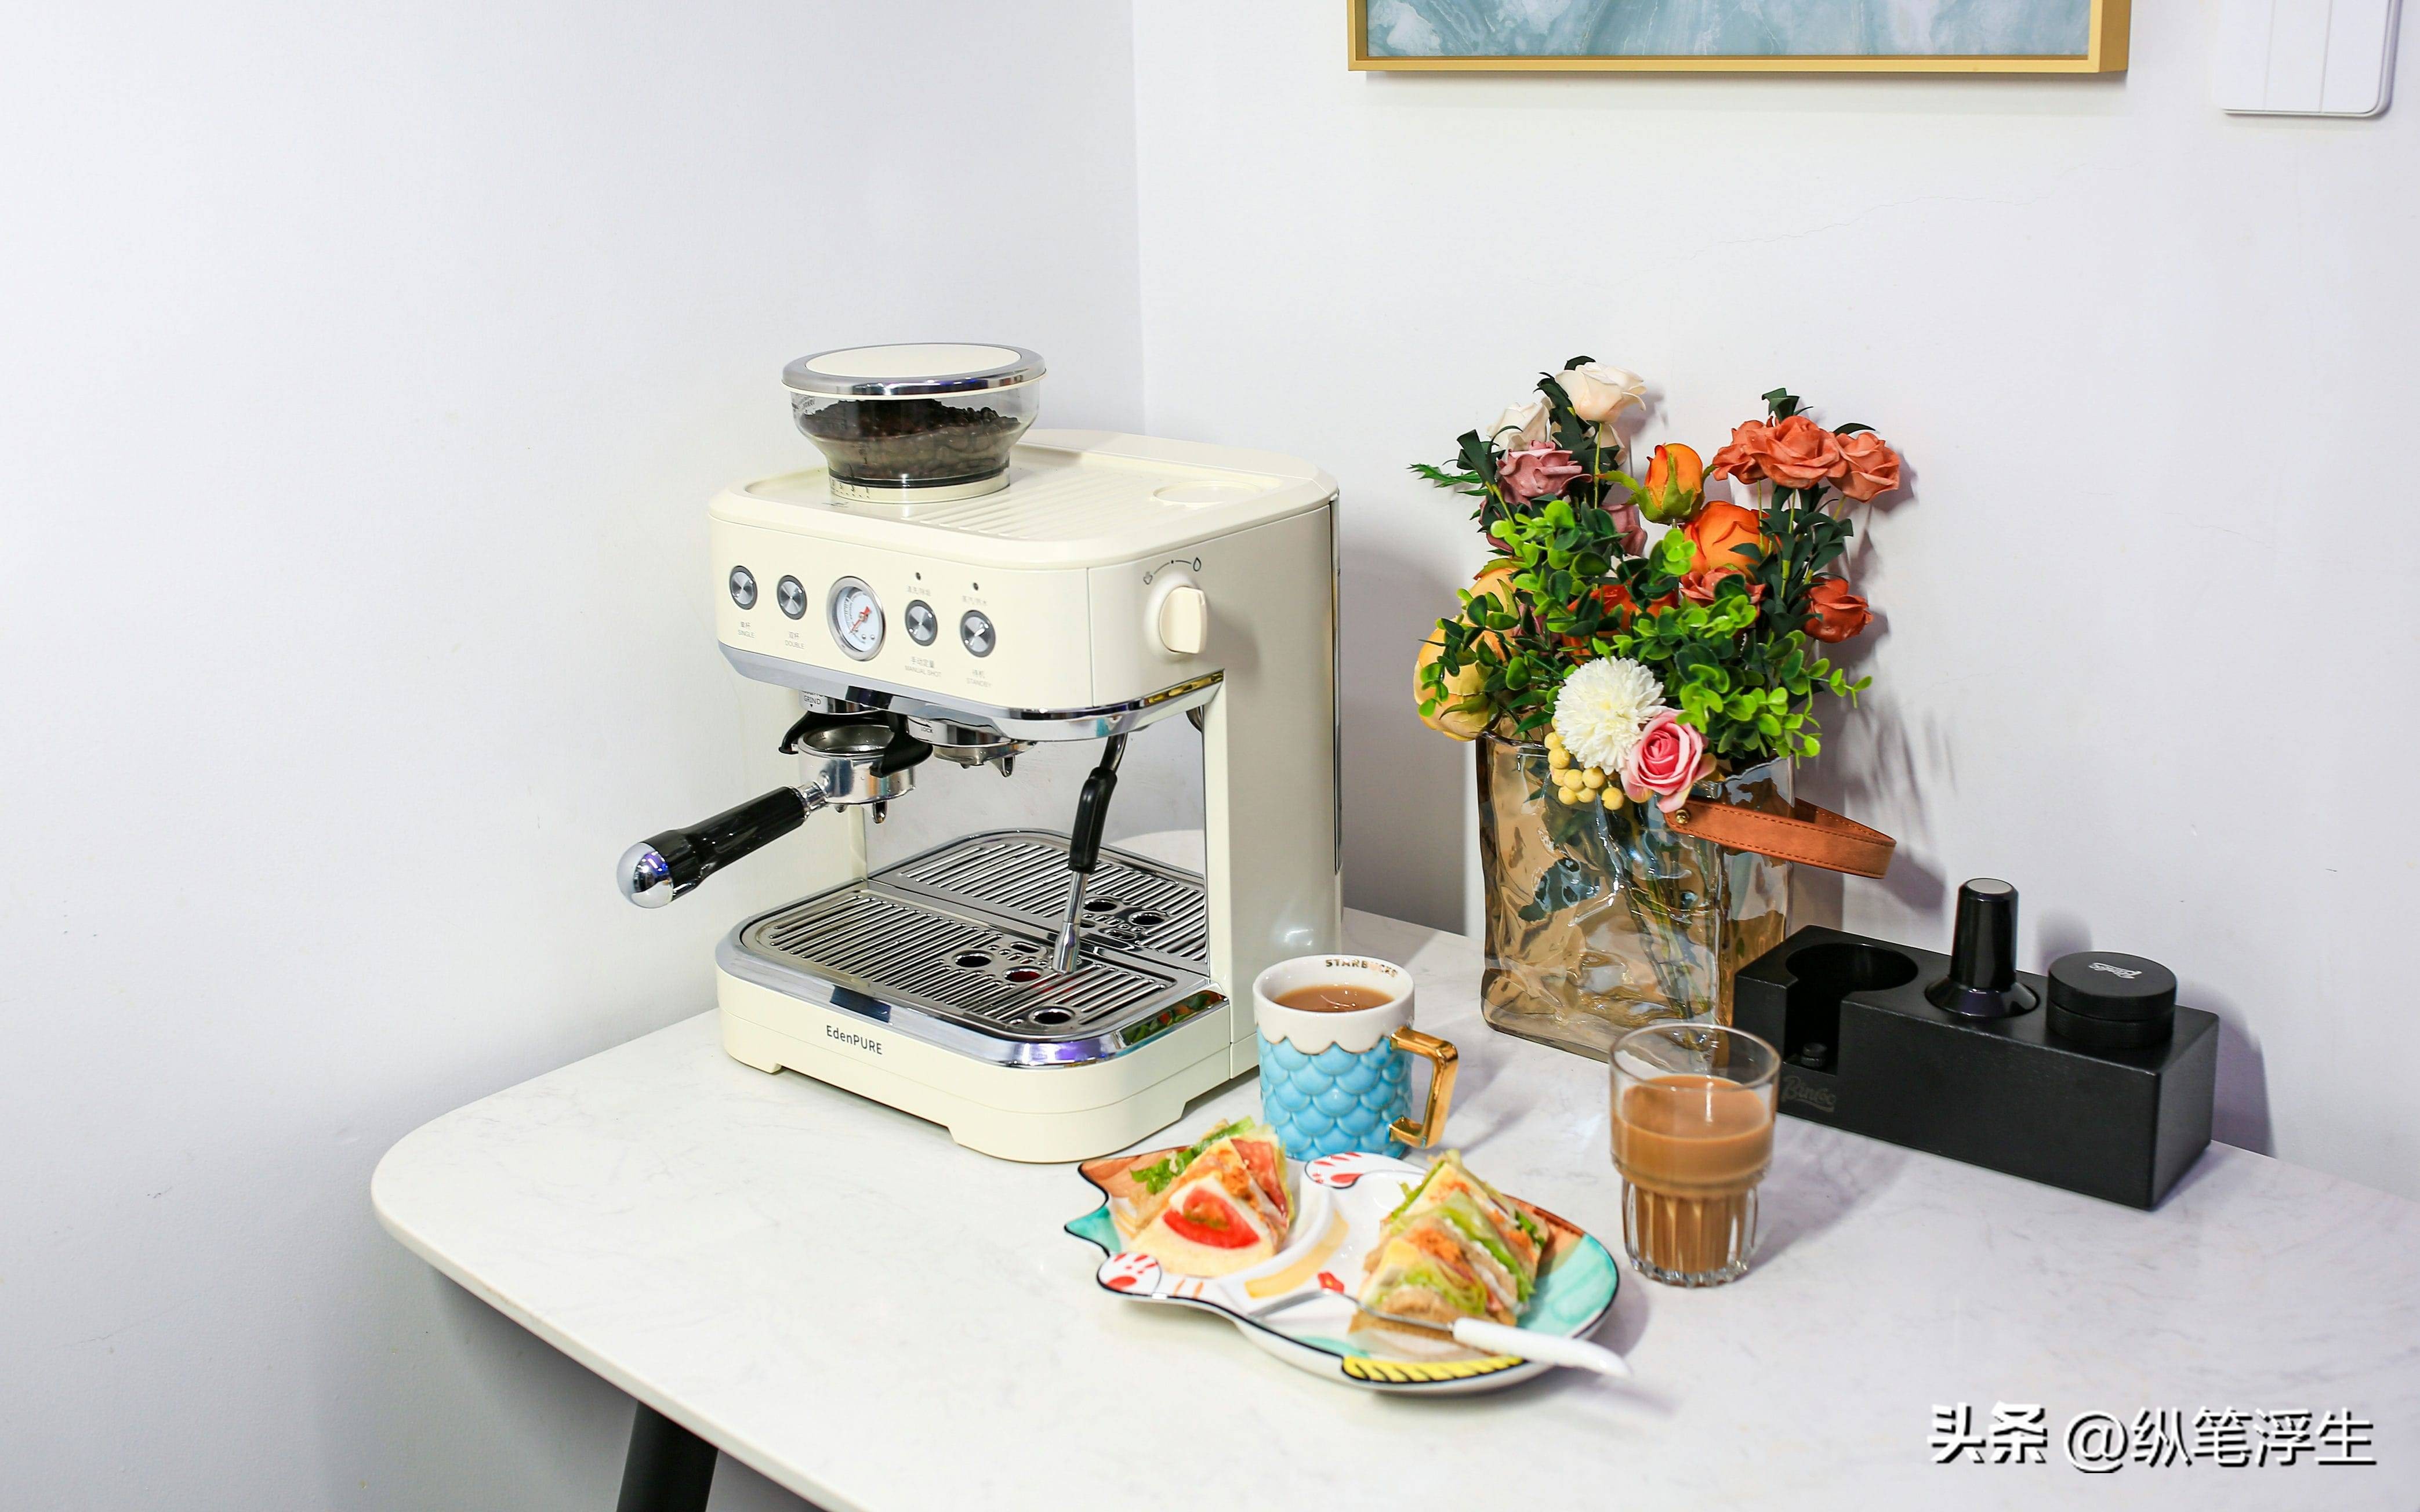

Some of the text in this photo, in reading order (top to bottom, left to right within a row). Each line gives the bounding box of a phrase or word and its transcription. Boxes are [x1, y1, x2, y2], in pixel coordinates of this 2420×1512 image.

[738, 630, 755, 638] SINGLE
[785, 639, 805, 649] DOUBLE
[803, 695, 822, 705] GRIND
[1325, 958, 1398, 978] STARBCKS
[826, 1024, 883, 1055] EdenPURE
